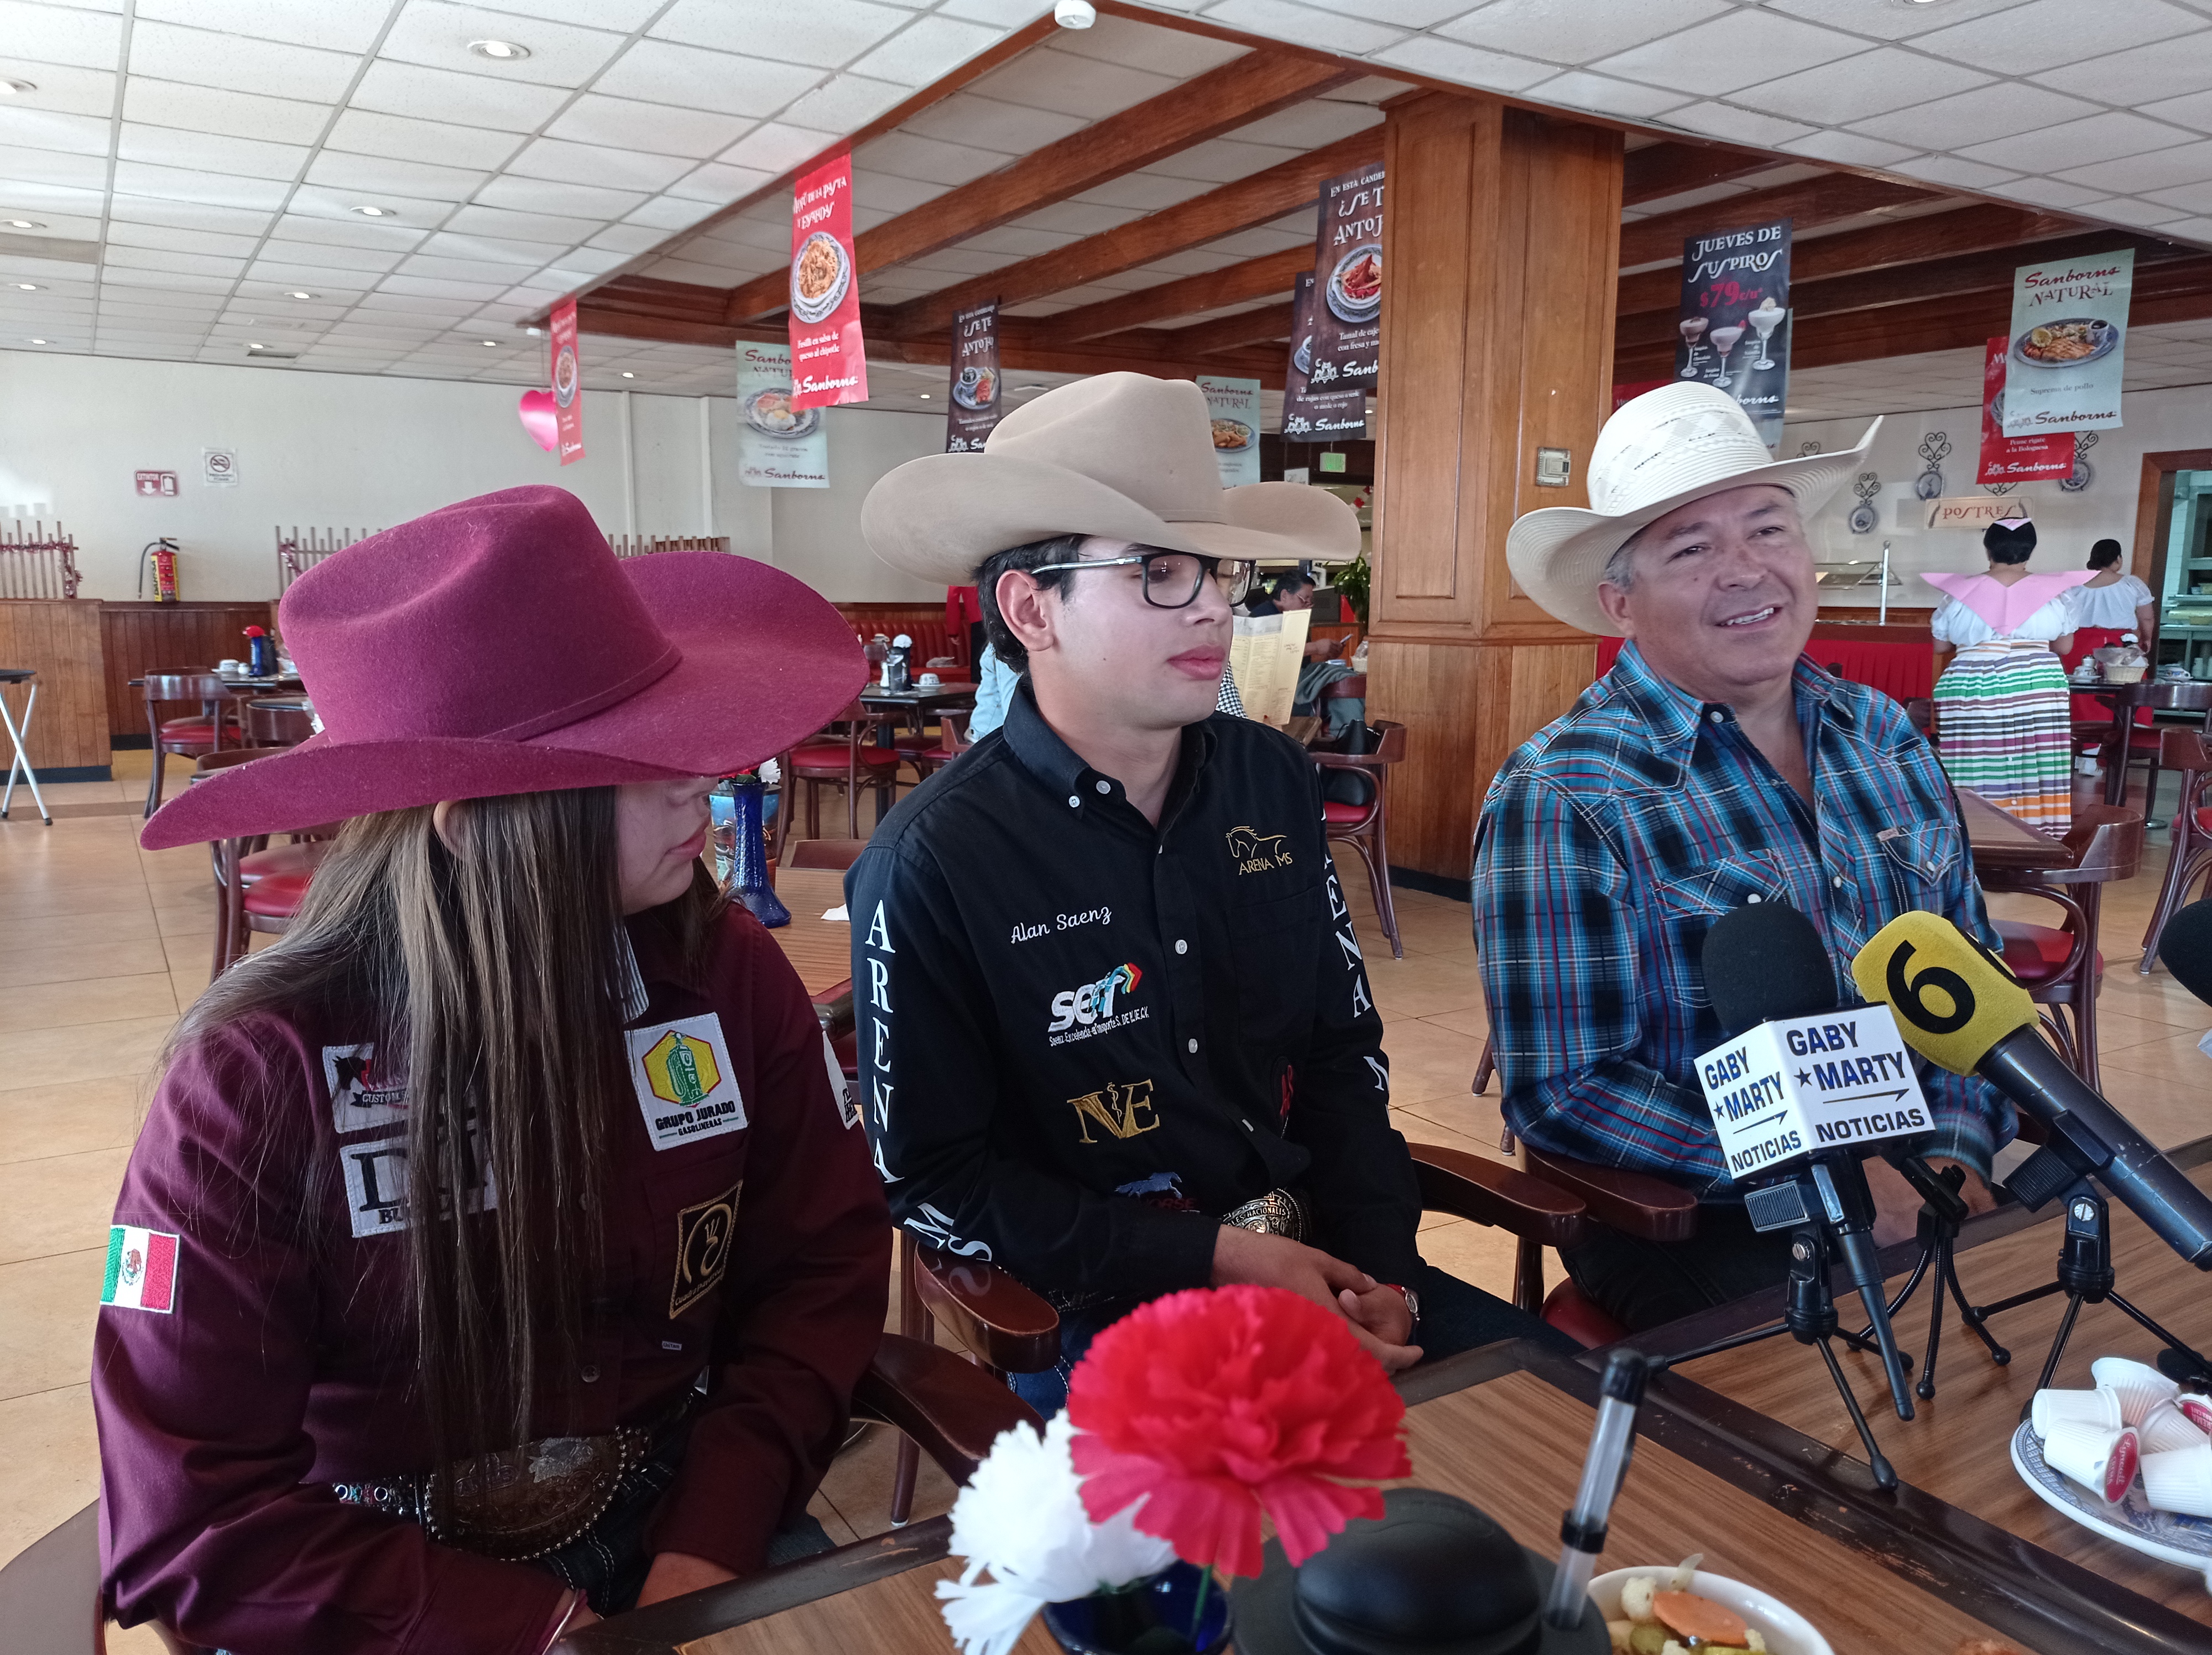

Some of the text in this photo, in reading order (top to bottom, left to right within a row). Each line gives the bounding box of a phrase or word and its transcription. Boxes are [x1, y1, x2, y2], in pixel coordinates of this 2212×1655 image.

[822, 175, 847, 199] PASTA
[1331, 185, 1340, 198] EN
[1342, 179, 1359, 191] ESTA
[1372, 185, 1385, 207] T
[1333, 214, 1384, 247] ANTOJ
[1692, 225, 1781, 262] JUEVES DE
[1688, 248, 1783, 283] SUSPIROS
[2025, 266, 2120, 289] Sanborns
[2028, 282, 2114, 307] NATURAL
[980, 316, 992, 332] TE
[818, 333, 831, 344] salsa
[831, 331, 839, 341] de
[1339, 331, 1358, 341] Tamal
[1366, 327, 1379, 337] caje
[799, 352, 813, 363] queso
[819, 344, 840, 357] chipotle
[1350, 341, 1365, 350] fresa
[745, 349, 791, 365] Sanbo
[754, 366, 792, 379] NATU
[1342, 360, 1378, 378] Sanb
[802, 375, 858, 393] Sanborns
[1200, 382, 1254, 397] Sanborns
[2030, 386, 2062, 395] Suprema
[2074, 382, 2094, 392] pollo
[1207, 396, 1251, 409] NATURAL
[1305, 395, 1319, 404] rajas
[1735, 394, 1780, 405] borns
[1314, 418, 1365, 431] Sanborns
[2035, 411, 2117, 425] Sanborns
[764, 469, 826, 481] Sanborns
[2006, 462, 2067, 473] Sanborns
[1942, 505, 2017, 520] POSTRES
[1239, 852, 1293, 876] ARENA MS
[1010, 907, 1112, 944] Alan Saenz
[1886, 940, 1975, 1034] 6
[864, 899, 906, 1184] ARENA
[1787, 1022, 1859, 1056] GABY
[1704, 1047, 1750, 1090] GABY
[1813, 1052, 1907, 1091] MARTY
[1723, 1072, 1785, 1122] MARTY
[655, 1100, 735, 1131] GRUPO JURADO
[1815, 1108, 1925, 1142] NOTICIAS
[678, 1117, 722, 1136] GASOLINERAS
[1731, 1130, 1802, 1172] NOTICIAS
